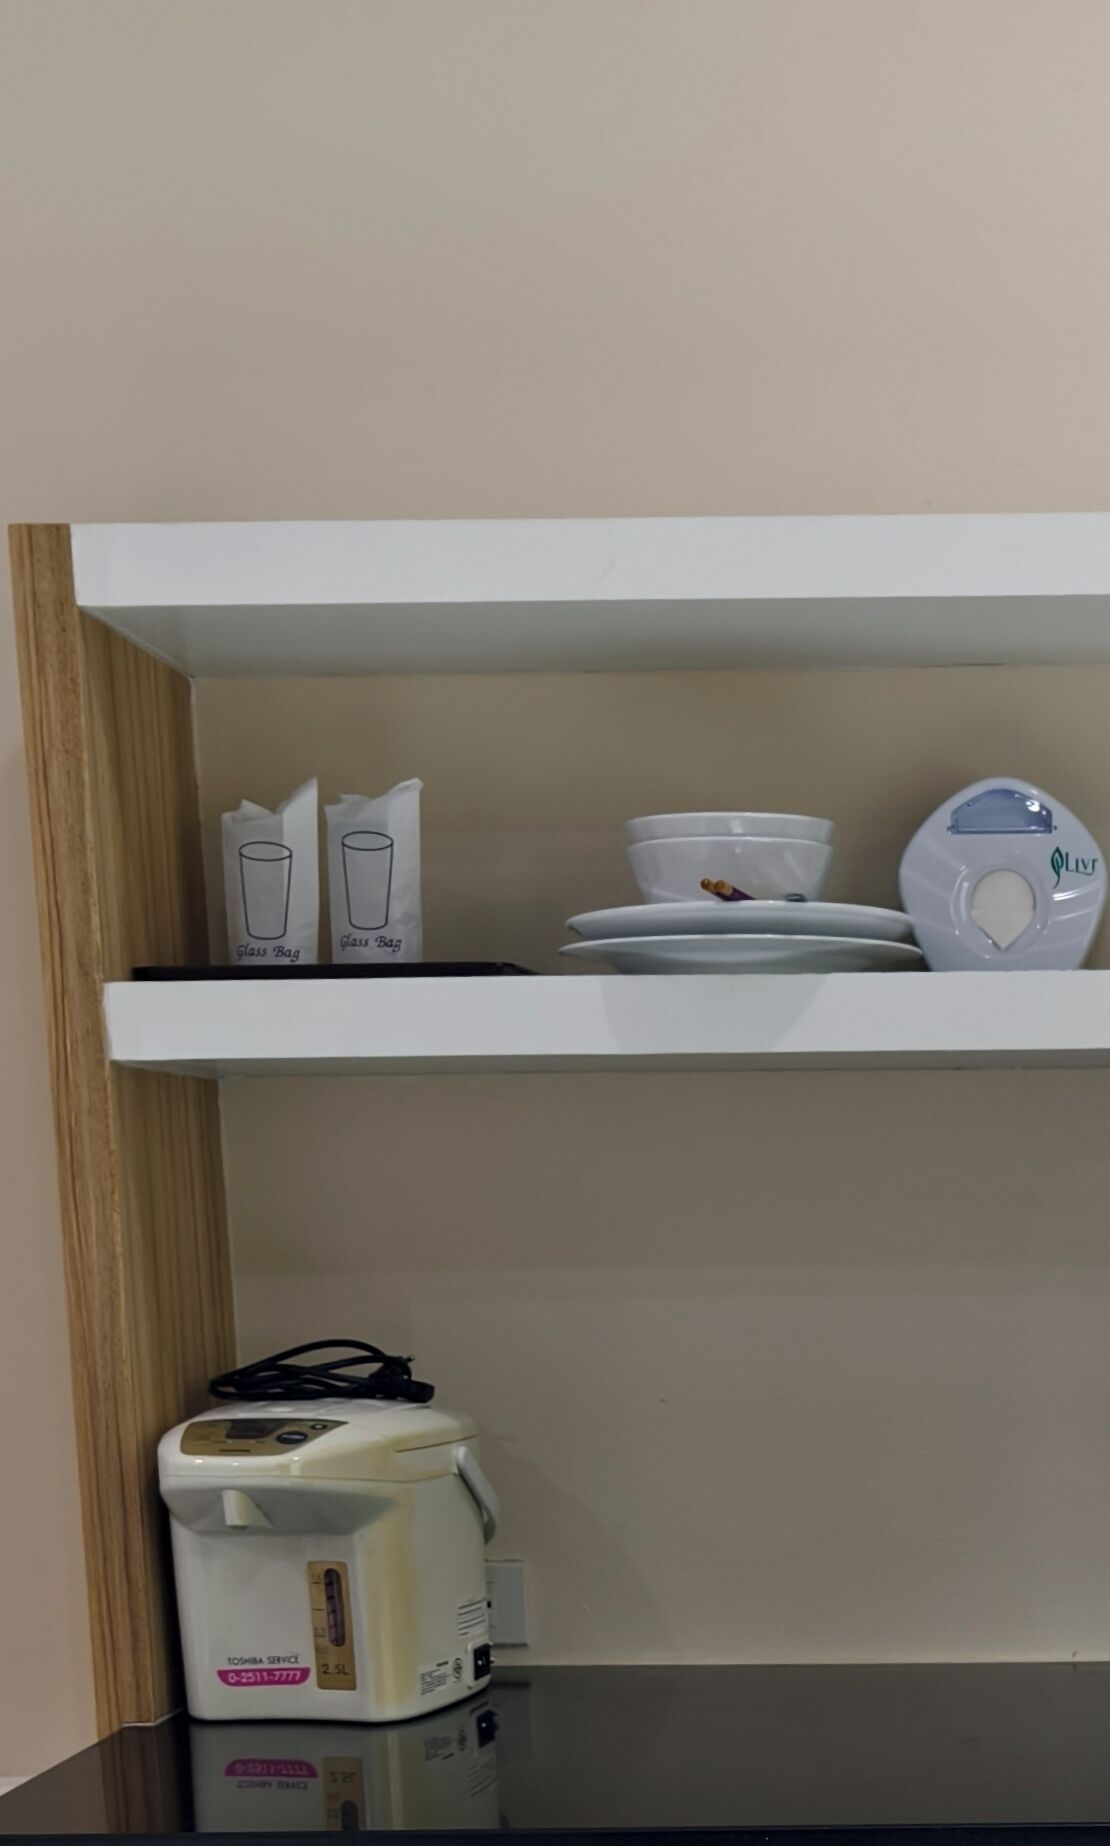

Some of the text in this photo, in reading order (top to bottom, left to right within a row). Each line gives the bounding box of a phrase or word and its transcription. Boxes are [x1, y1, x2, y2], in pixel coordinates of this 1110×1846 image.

[340, 933, 402, 952] Glass Bag
[236, 943, 300, 963] Glass Bag
[227, 1655, 299, 1666] TOSHIBA SERVICE
[228, 1670, 302, 1683] 0-2511-7777
